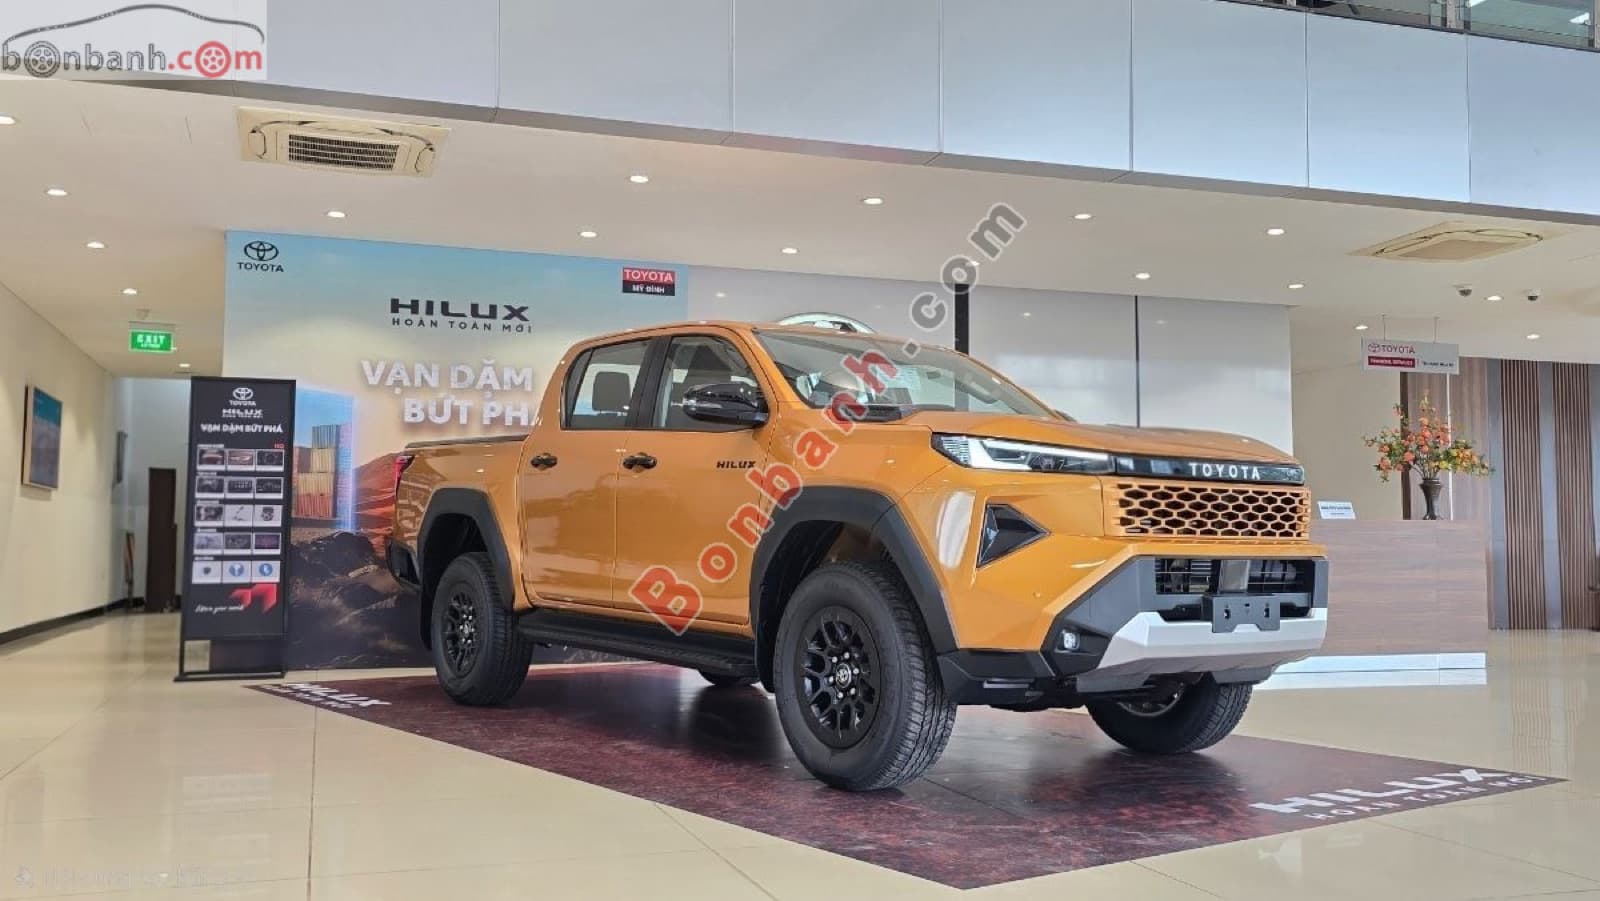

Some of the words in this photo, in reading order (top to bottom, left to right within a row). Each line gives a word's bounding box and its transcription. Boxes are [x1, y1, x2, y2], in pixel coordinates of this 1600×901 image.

[237, 262, 284, 272] TOYOTA
[624, 269, 673, 282] TOYOTA
[390, 298, 530, 321] HILUX
[392, 317, 438, 328] HOÀN
[449, 320, 492, 331] TOÀN
[137, 334, 165, 344] EXIT
[1381, 345, 1415, 353] TOYOTA
[361, 360, 440, 394] VẠN
[450, 359, 533, 398] DẶM
[404, 392, 473, 424] BỨT
[482, 400, 541, 426] PH
[716, 460, 756, 469] HILUX
[1189, 463, 1261, 480] TOYOTA
[1249, 769, 1511, 813] HILUX
